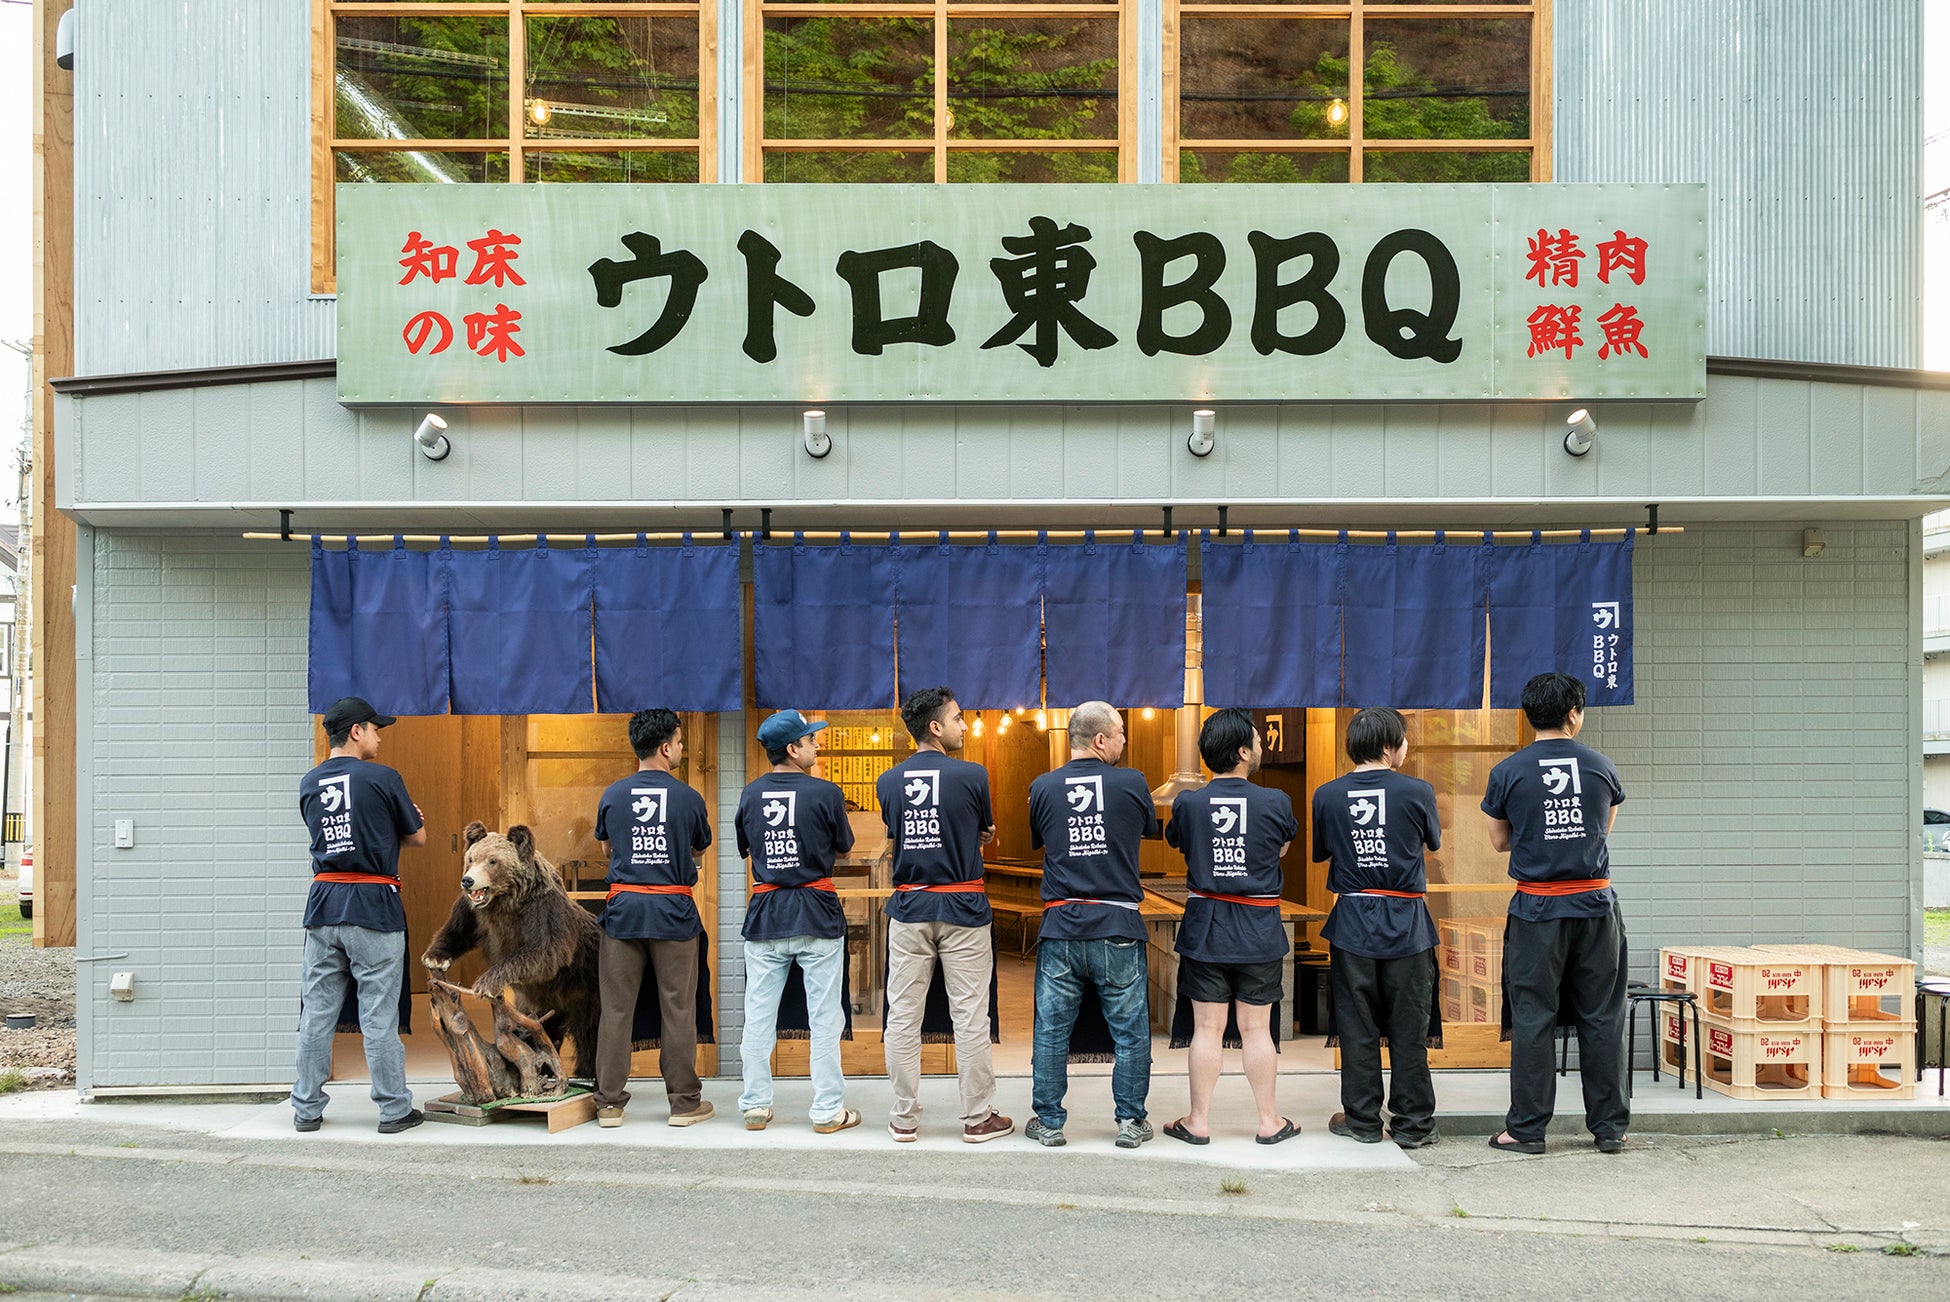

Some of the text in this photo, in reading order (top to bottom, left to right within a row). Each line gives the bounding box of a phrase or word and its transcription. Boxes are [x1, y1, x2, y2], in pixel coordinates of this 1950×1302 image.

[399, 230, 526, 288] 知床
[1526, 229, 1648, 288] 精肉
[588, 216, 1462, 367] ウトロ東BBQ
[403, 304, 525, 362] の味
[1527, 303, 1648, 360] 鮮魚
[1593, 635, 1605, 678] BBQ
[1606, 634, 1619, 689] ウトロ東
[1545, 808, 1583, 825] BBQ
[323, 824, 352, 841] BBQ
[905, 819, 940, 835] BBQ
[1069, 826, 1105, 842] BBQ
[632, 836, 667, 851] BBQ
[765, 840, 797, 855] BBQ
[1353, 839, 1386, 855] BBQ
[1213, 848, 1245, 863] BBQ
[1768, 978, 1796, 989] Asahi
[1859, 978, 1888, 989] Asahi
[1766, 1046, 1795, 1058] Asahi
[1859, 1046, 1888, 1057] Asahi
